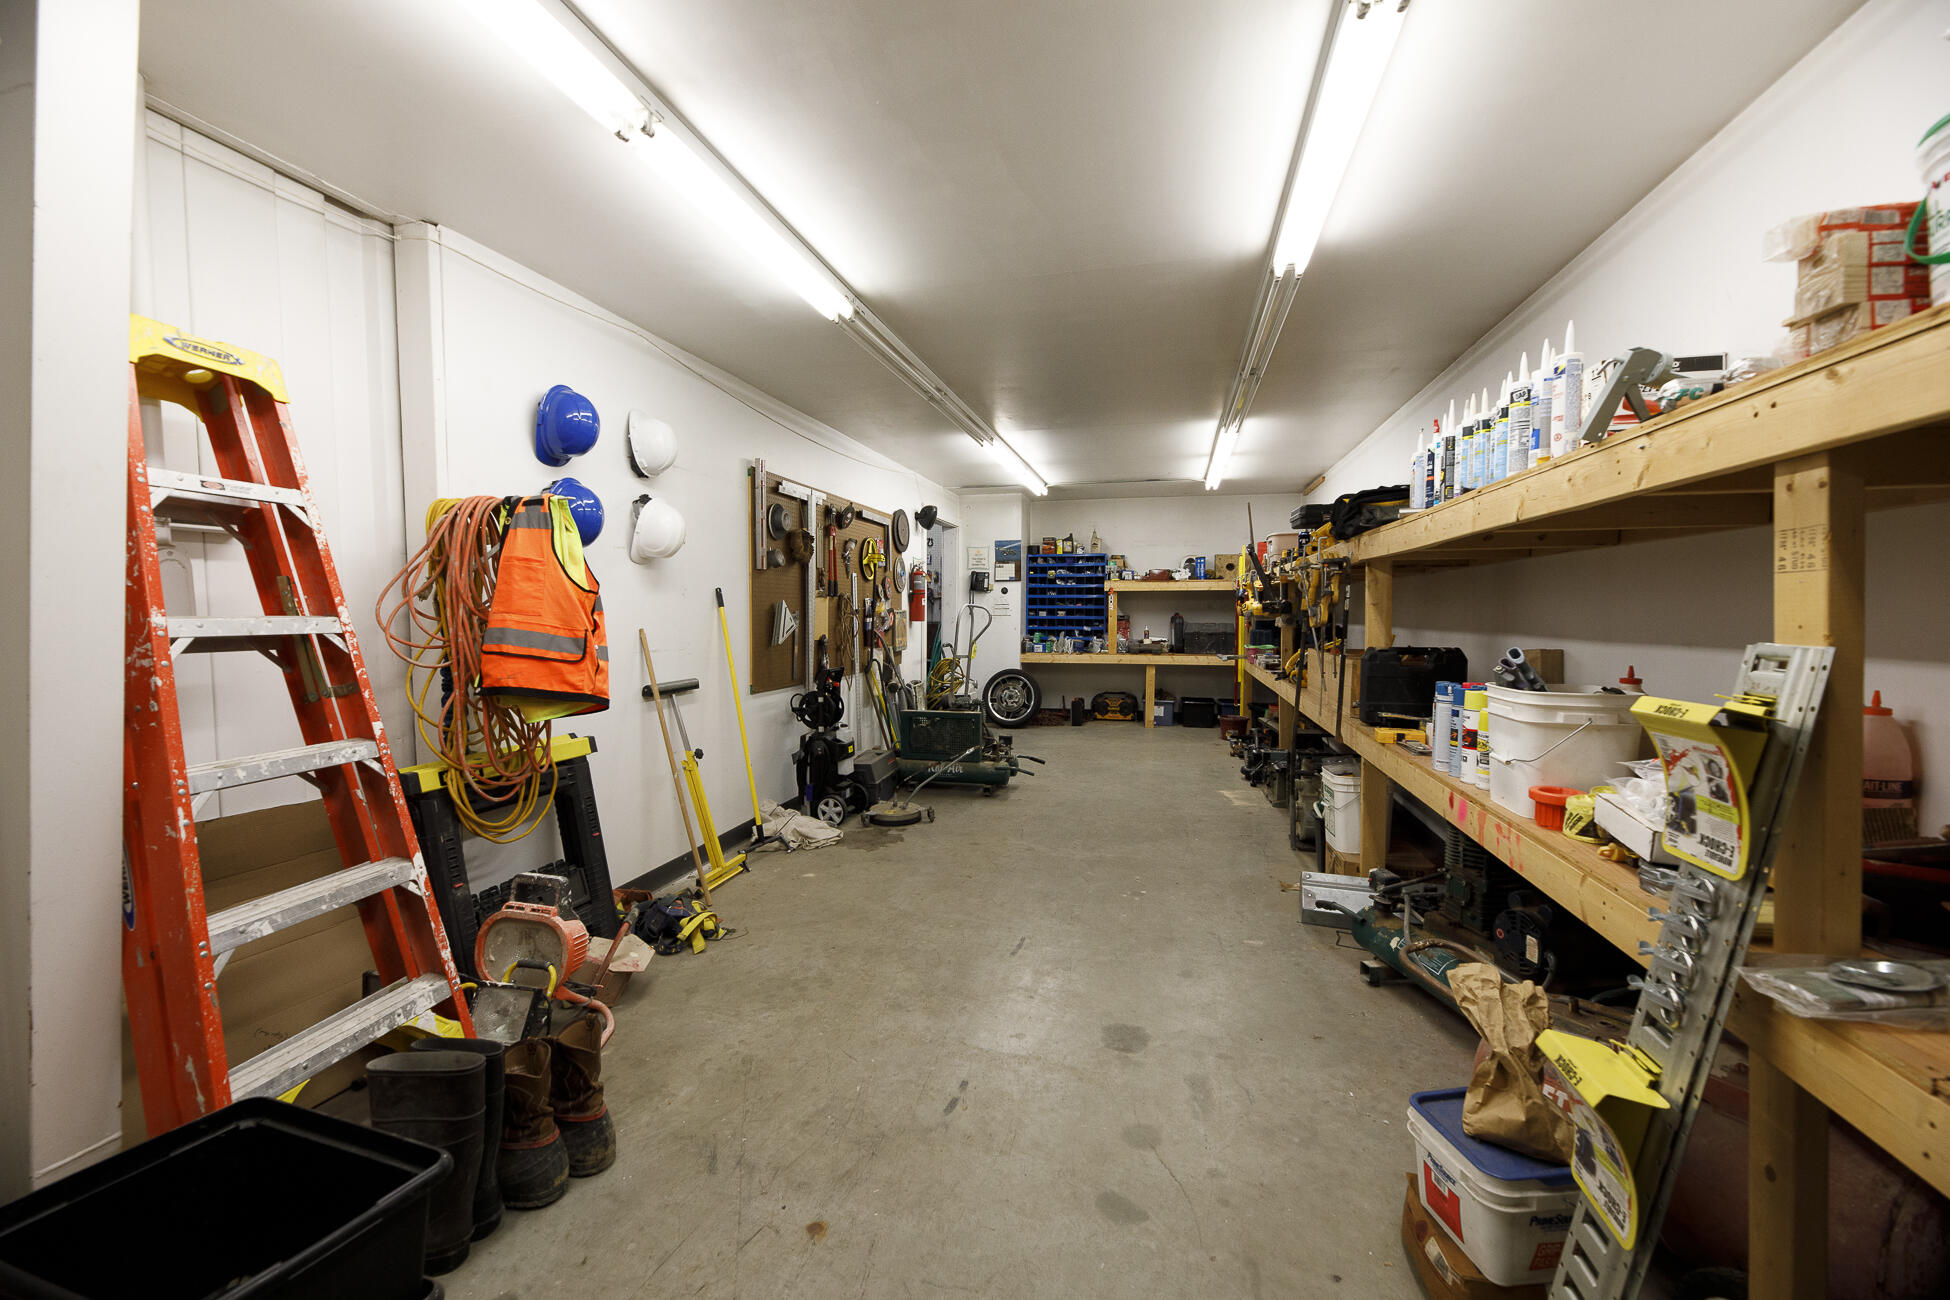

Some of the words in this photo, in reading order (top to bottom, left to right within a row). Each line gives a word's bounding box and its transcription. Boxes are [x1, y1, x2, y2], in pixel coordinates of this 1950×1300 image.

[180, 341, 231, 361] WERNER
[1667, 387, 1704, 401] FC
[1863, 781, 1903, 793] AIT-LINE
